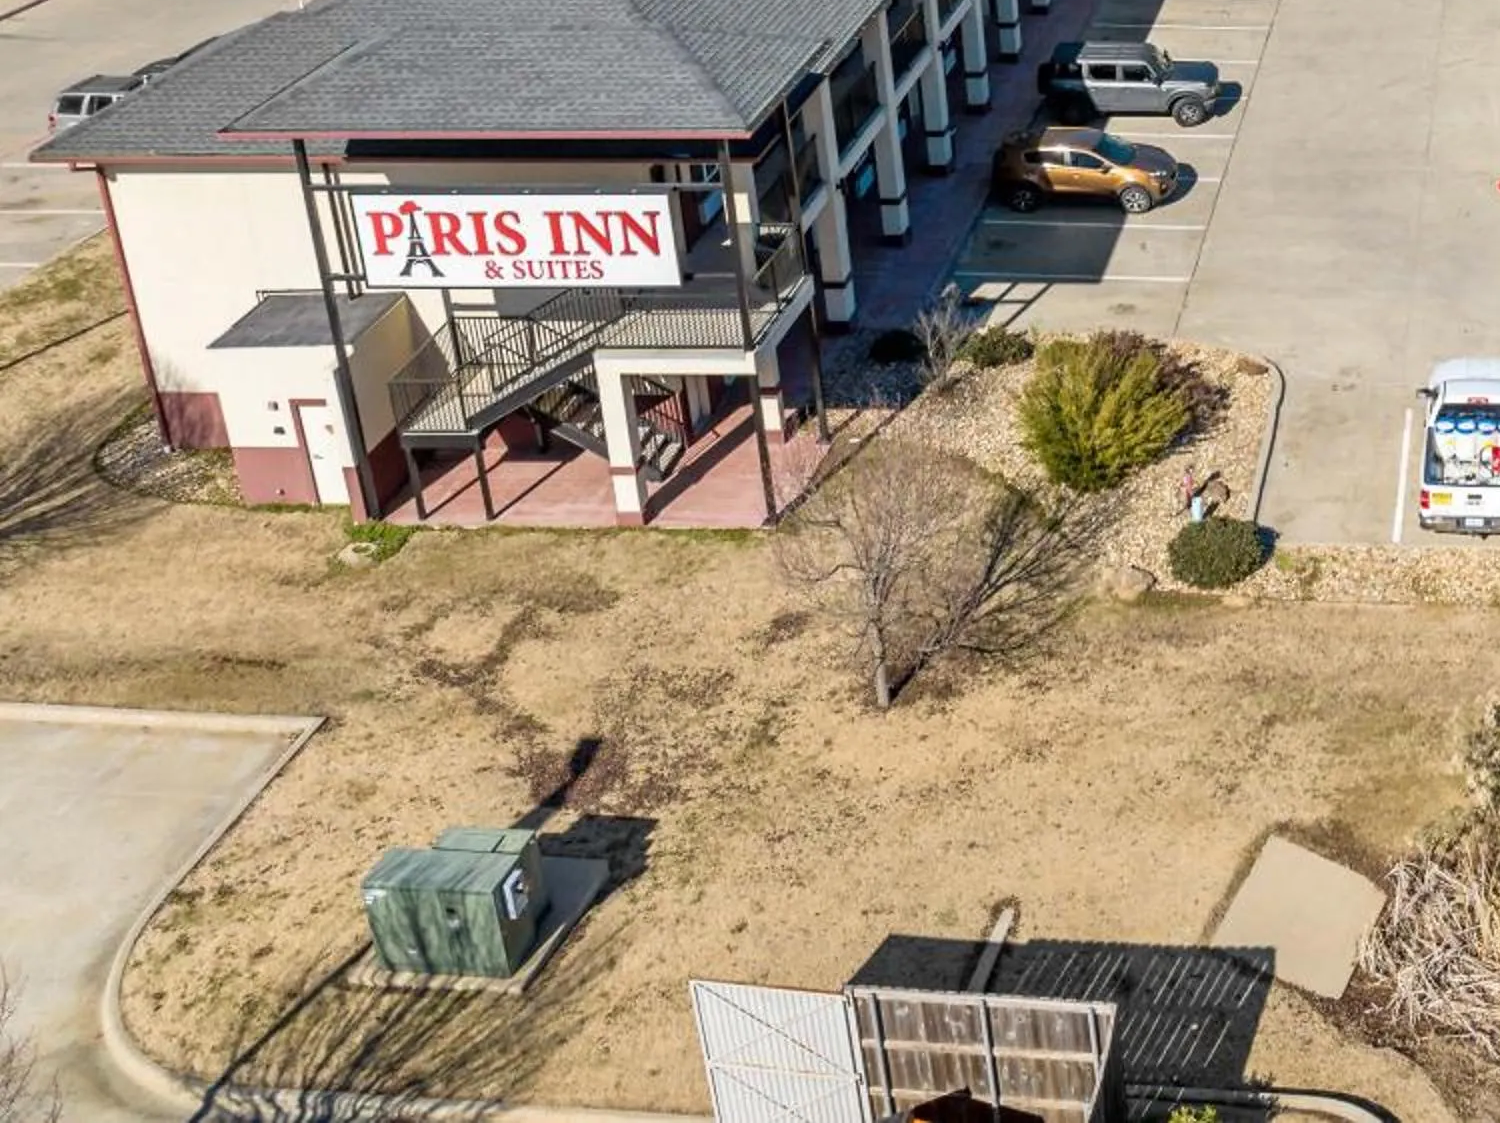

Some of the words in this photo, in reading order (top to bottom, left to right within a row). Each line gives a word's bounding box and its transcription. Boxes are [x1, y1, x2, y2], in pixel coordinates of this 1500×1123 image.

[366, 201, 528, 278] PARIS
[543, 210, 661, 257] INN
[484, 260, 504, 280] &
[512, 260, 605, 280] SUITES
